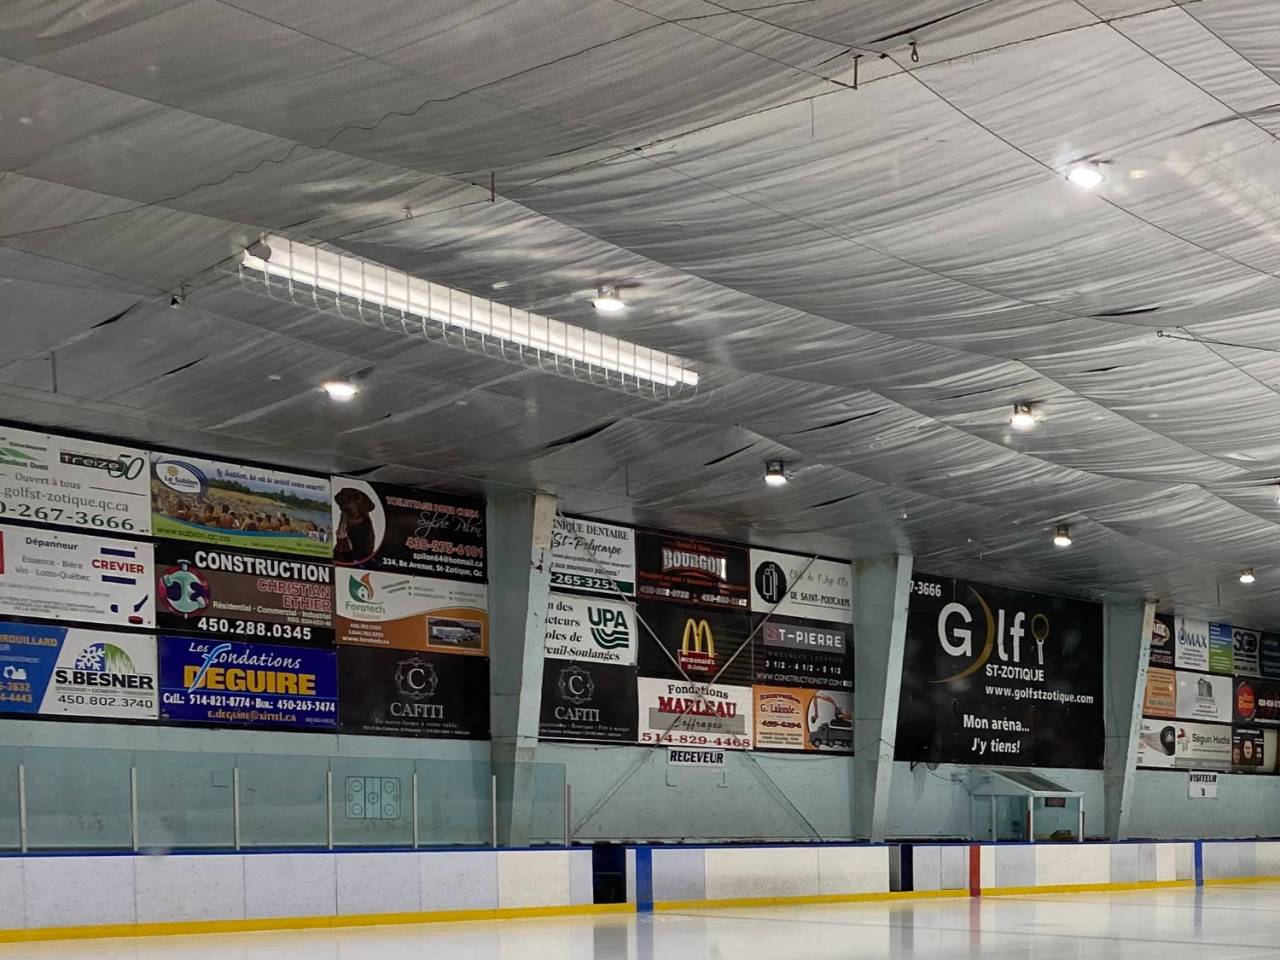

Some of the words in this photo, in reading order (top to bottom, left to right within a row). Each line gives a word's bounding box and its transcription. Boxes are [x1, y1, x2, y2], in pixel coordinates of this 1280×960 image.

[15, 472, 49, 485] Ouvert
[51, 476, 57, 486] à
[60, 479, 81, 489] tous
[587, 525, 629, 540] DENTAIRE
[25, 536, 78, 550] Dépanneur
[22, 555, 55, 567] Essence
[91, 558, 144, 574] CREVIER
[195, 551, 329, 583] CONSTRUCTION
[662, 549, 727, 580] BOURGON
[15, 566, 29, 575] Vin
[35, 568, 91, 582] Lotto-Québec
[257, 579, 330, 600] CHRISTIAN
[282, 595, 331, 612] ETHIER
[345, 600, 386, 615] Foratech
[556, 601, 574, 612] des
[587, 606, 629, 630] UPA
[197, 617, 311, 640] 450.288.0345
[570, 632, 583, 642] de
[189, 642, 209, 653] Les
[773, 661, 785, 669] 1/2
[802, 664, 814, 672] 1/2
[985, 664, 1045, 682] ST-ZOTIQUE
[55, 669, 154, 690] S.BESNER
[183, 664, 316, 696] DEGUIRE
[407, 668, 426, 690] C
[569, 675, 585, 694] C
[667, 684, 729, 699] Fondations
[985, 684, 1094, 705] www.golfstzotique.com
[277, 699, 335, 713] 450-265-3474
[390, 702, 444, 719] CAFITI
[554, 706, 600, 721] CAFITI
[658, 696, 737, 718] MARLEAU
[963, 714, 989, 729] Mon
[991, 716, 1030, 732] aréna...
[642, 732, 751, 748] 514-829-4468
[971, 737, 988, 755] J'y
[990, 739, 1020, 754] tiens!
[1192, 733, 1213, 746] Séguin
[670, 750, 724, 763] RECEVEUR
[1189, 774, 1217, 783] VISITEUR
